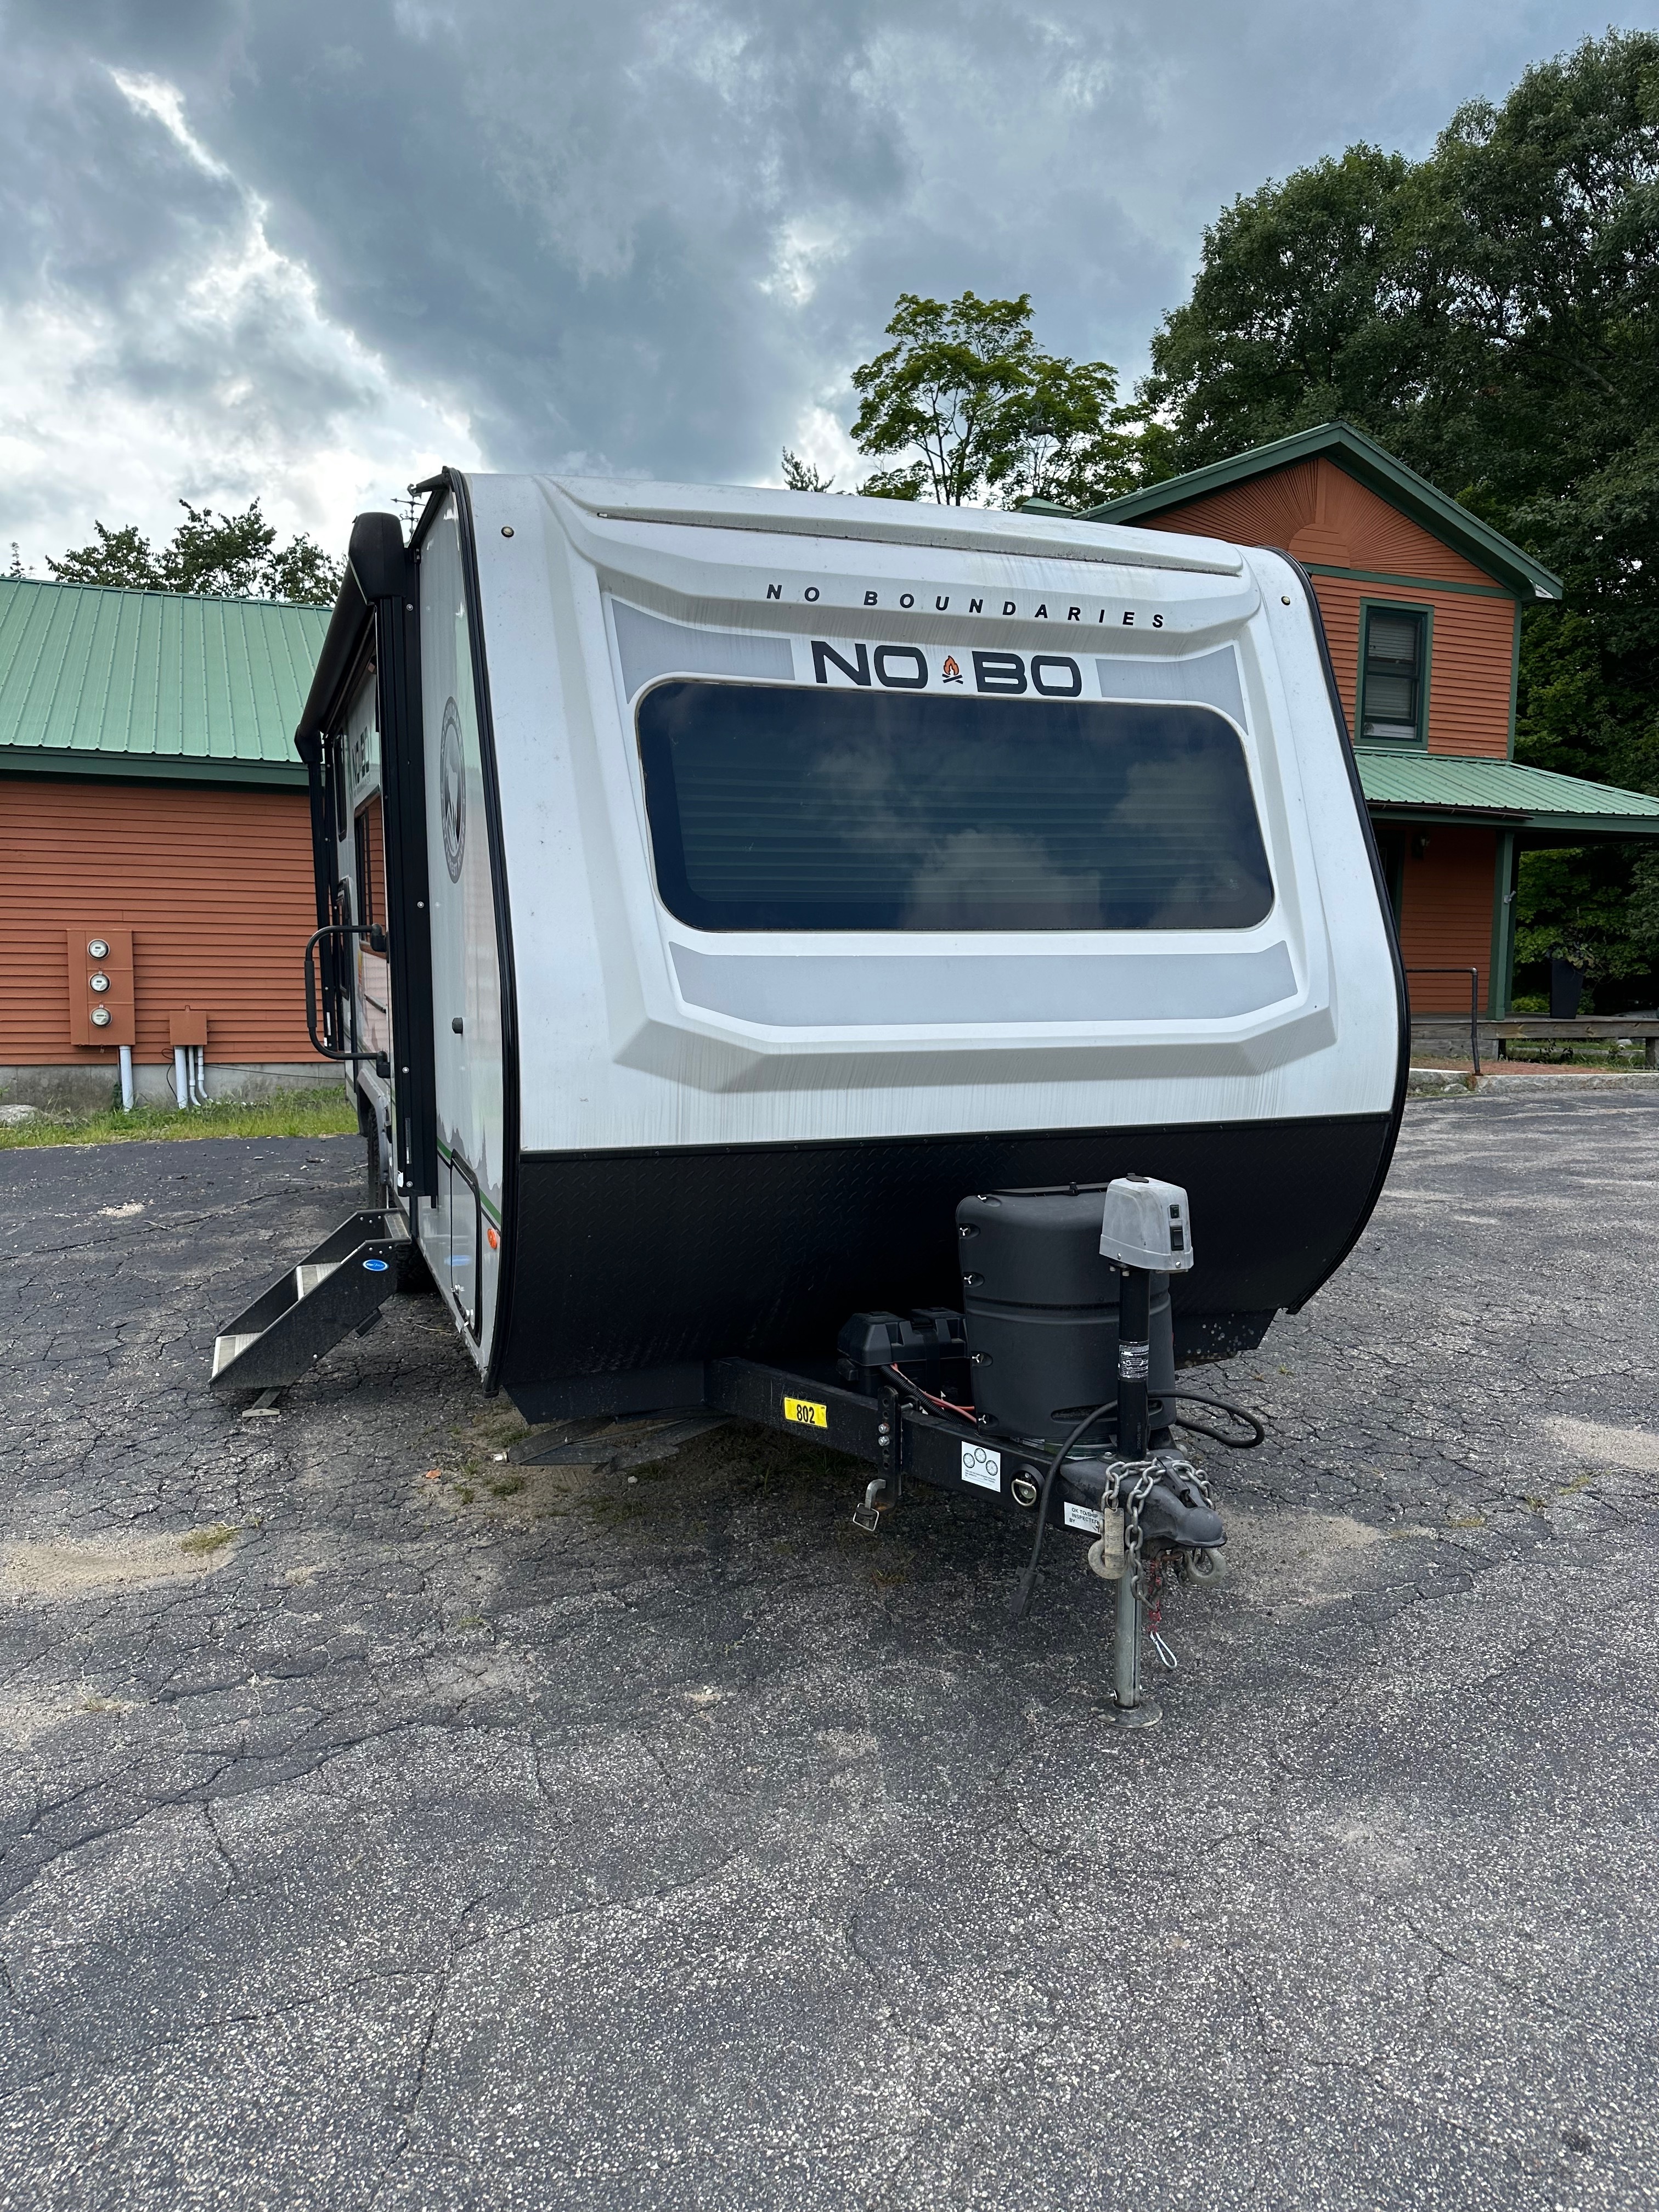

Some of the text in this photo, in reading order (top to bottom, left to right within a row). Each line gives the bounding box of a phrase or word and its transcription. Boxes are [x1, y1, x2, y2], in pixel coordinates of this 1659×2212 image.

[766, 584, 1164, 629] NO BOUNDARIES
[810, 640, 1082, 697] NO BO
[797, 1403, 815, 1424] 802
